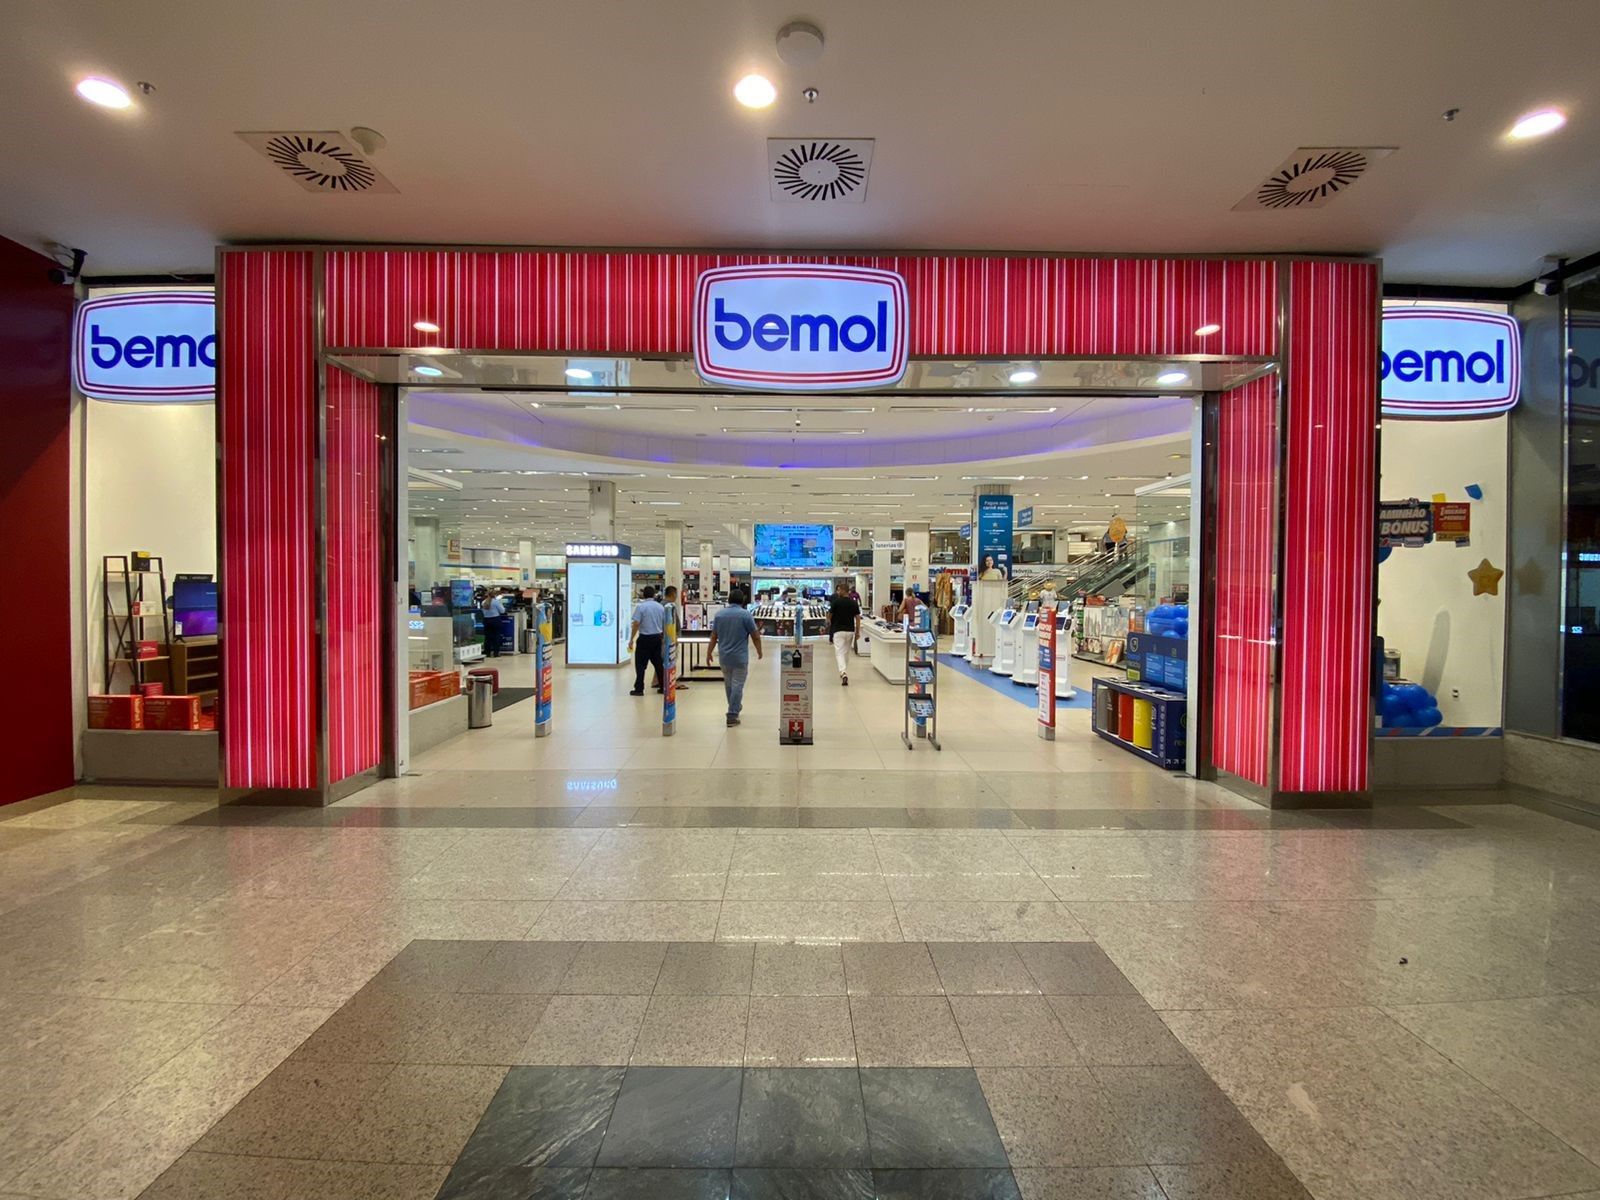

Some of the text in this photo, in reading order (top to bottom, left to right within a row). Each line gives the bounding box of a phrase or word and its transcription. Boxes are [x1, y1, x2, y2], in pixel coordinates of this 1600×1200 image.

[714, 297, 888, 353] bemol
[91, 324, 216, 370] bemo
[1380, 507, 1426, 519] AMINHÃO
[566, 544, 619, 556] SAMSUNG
